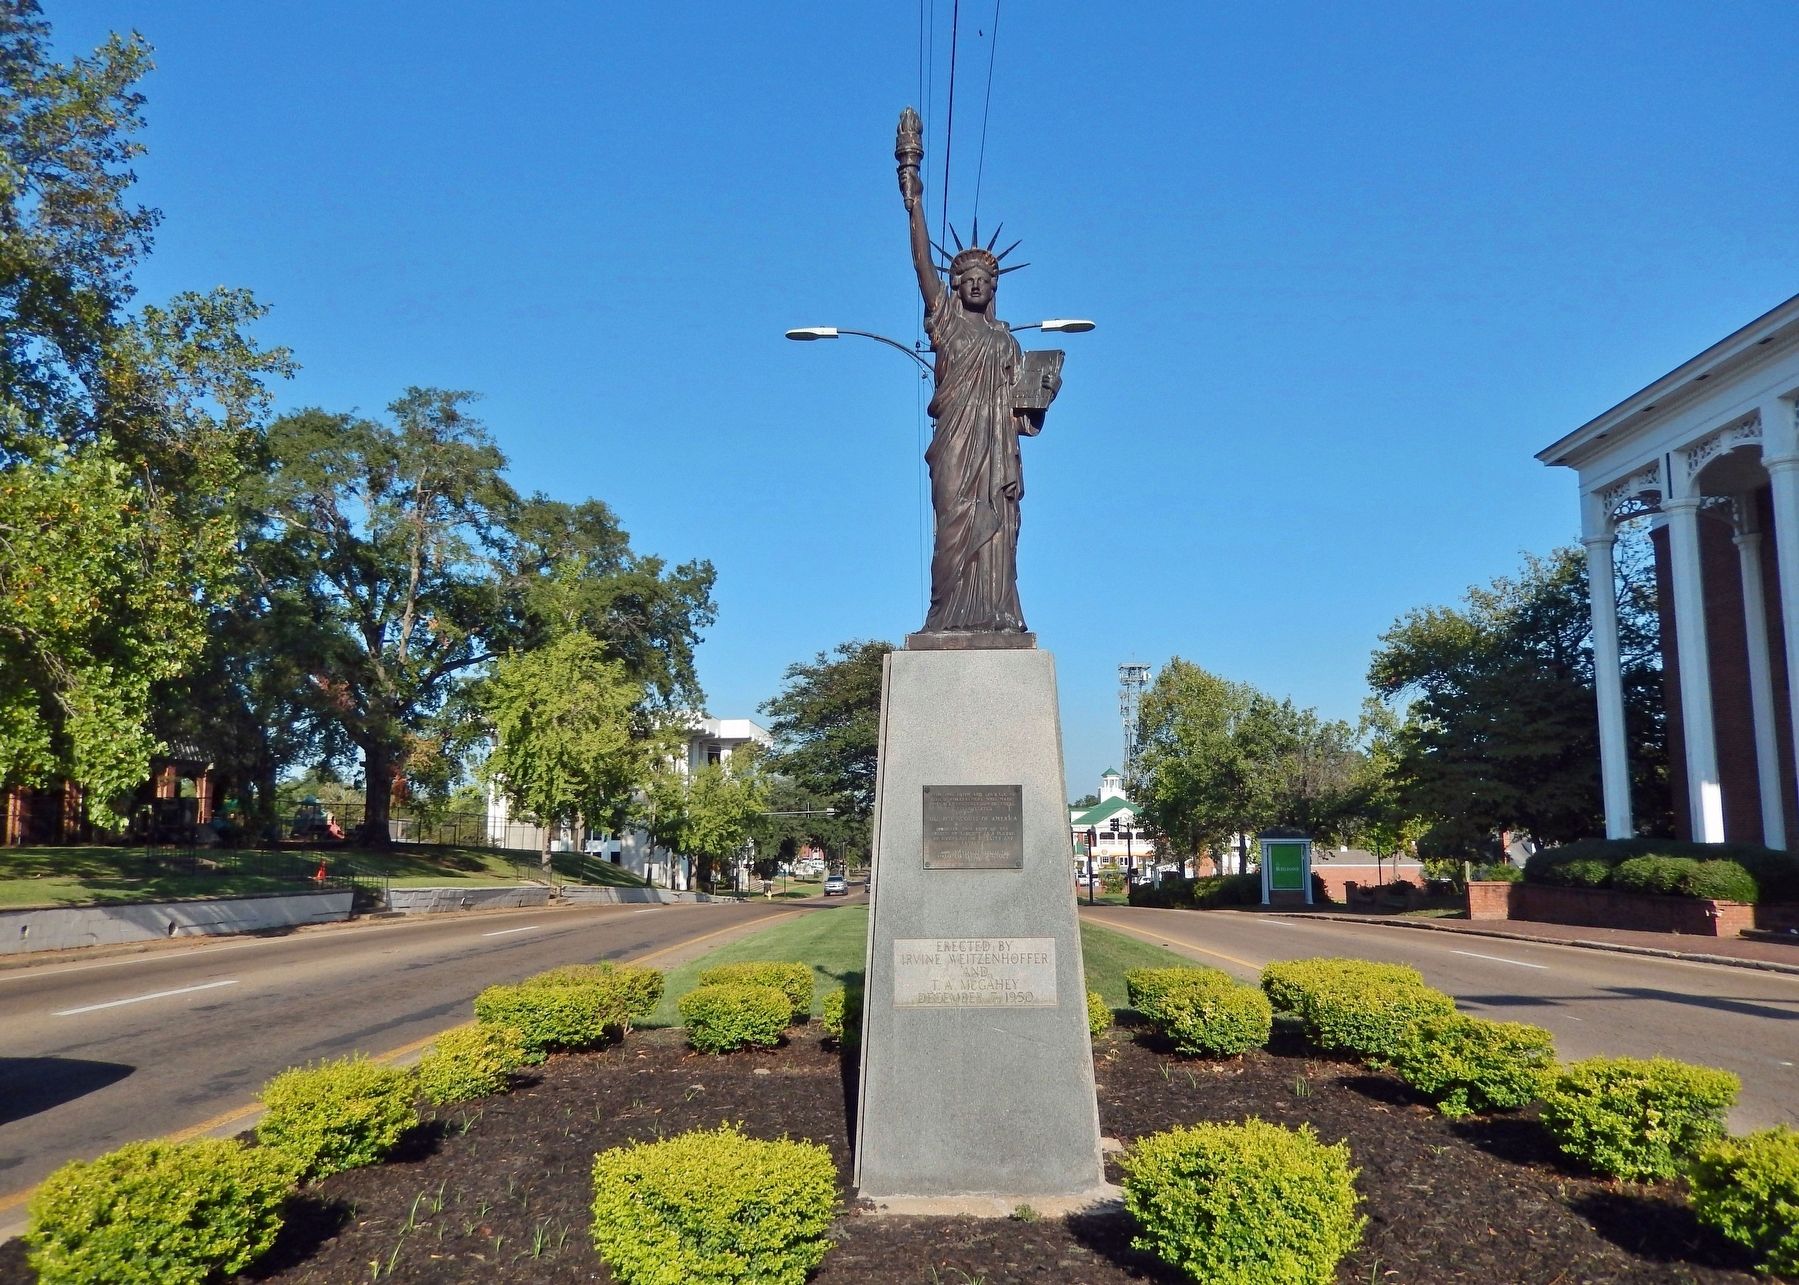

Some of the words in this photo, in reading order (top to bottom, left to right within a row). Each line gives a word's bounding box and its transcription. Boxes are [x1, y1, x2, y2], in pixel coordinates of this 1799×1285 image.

[936, 940, 991, 953] ERECTED
[998, 940, 1013, 952] BY
[902, 954, 942, 966] IRVINE
[949, 953, 1049, 966] WEITZENHOFFER
[962, 966, 988, 977] AND
[1005, 991, 1034, 1004] 1950
